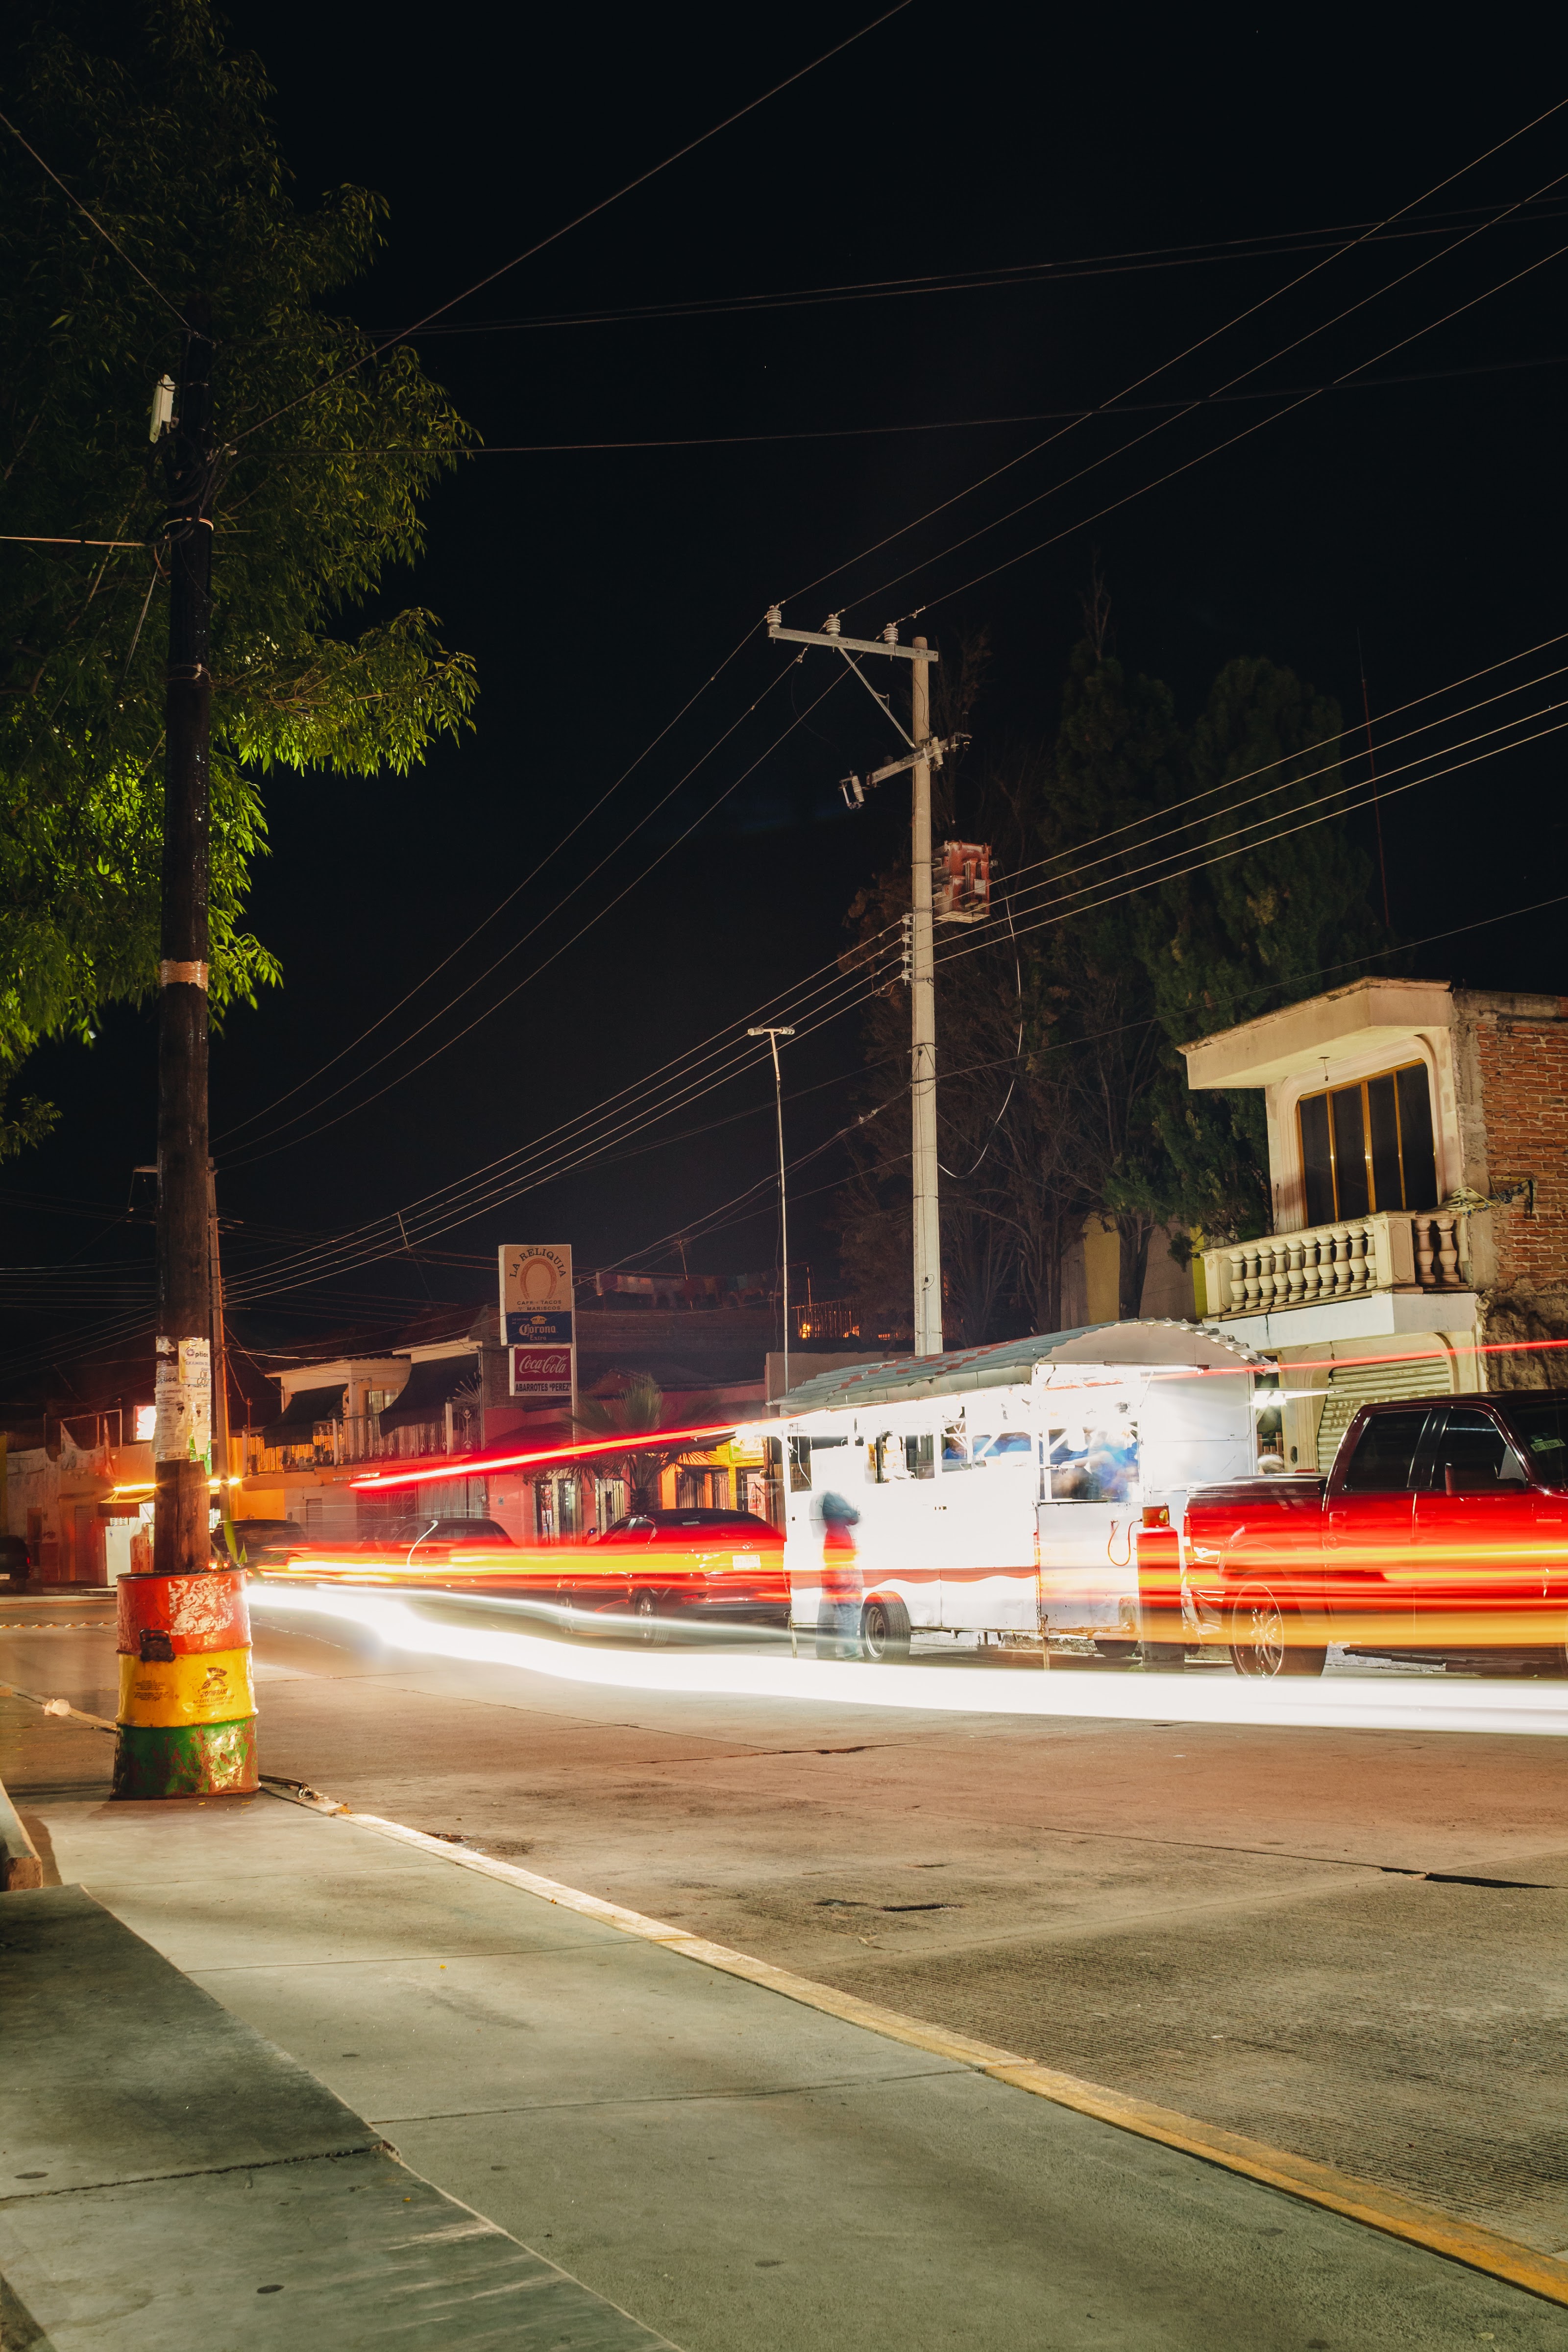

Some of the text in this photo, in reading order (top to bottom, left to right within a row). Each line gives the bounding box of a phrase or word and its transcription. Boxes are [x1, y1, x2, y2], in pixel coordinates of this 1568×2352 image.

[510, 1248, 566, 1277] LA RELIQUIA
[519, 1323, 556, 1337] Corona
[519, 1355, 569, 1373] Coca-Cola
[515, 1383, 548, 1392] ABARROTES
